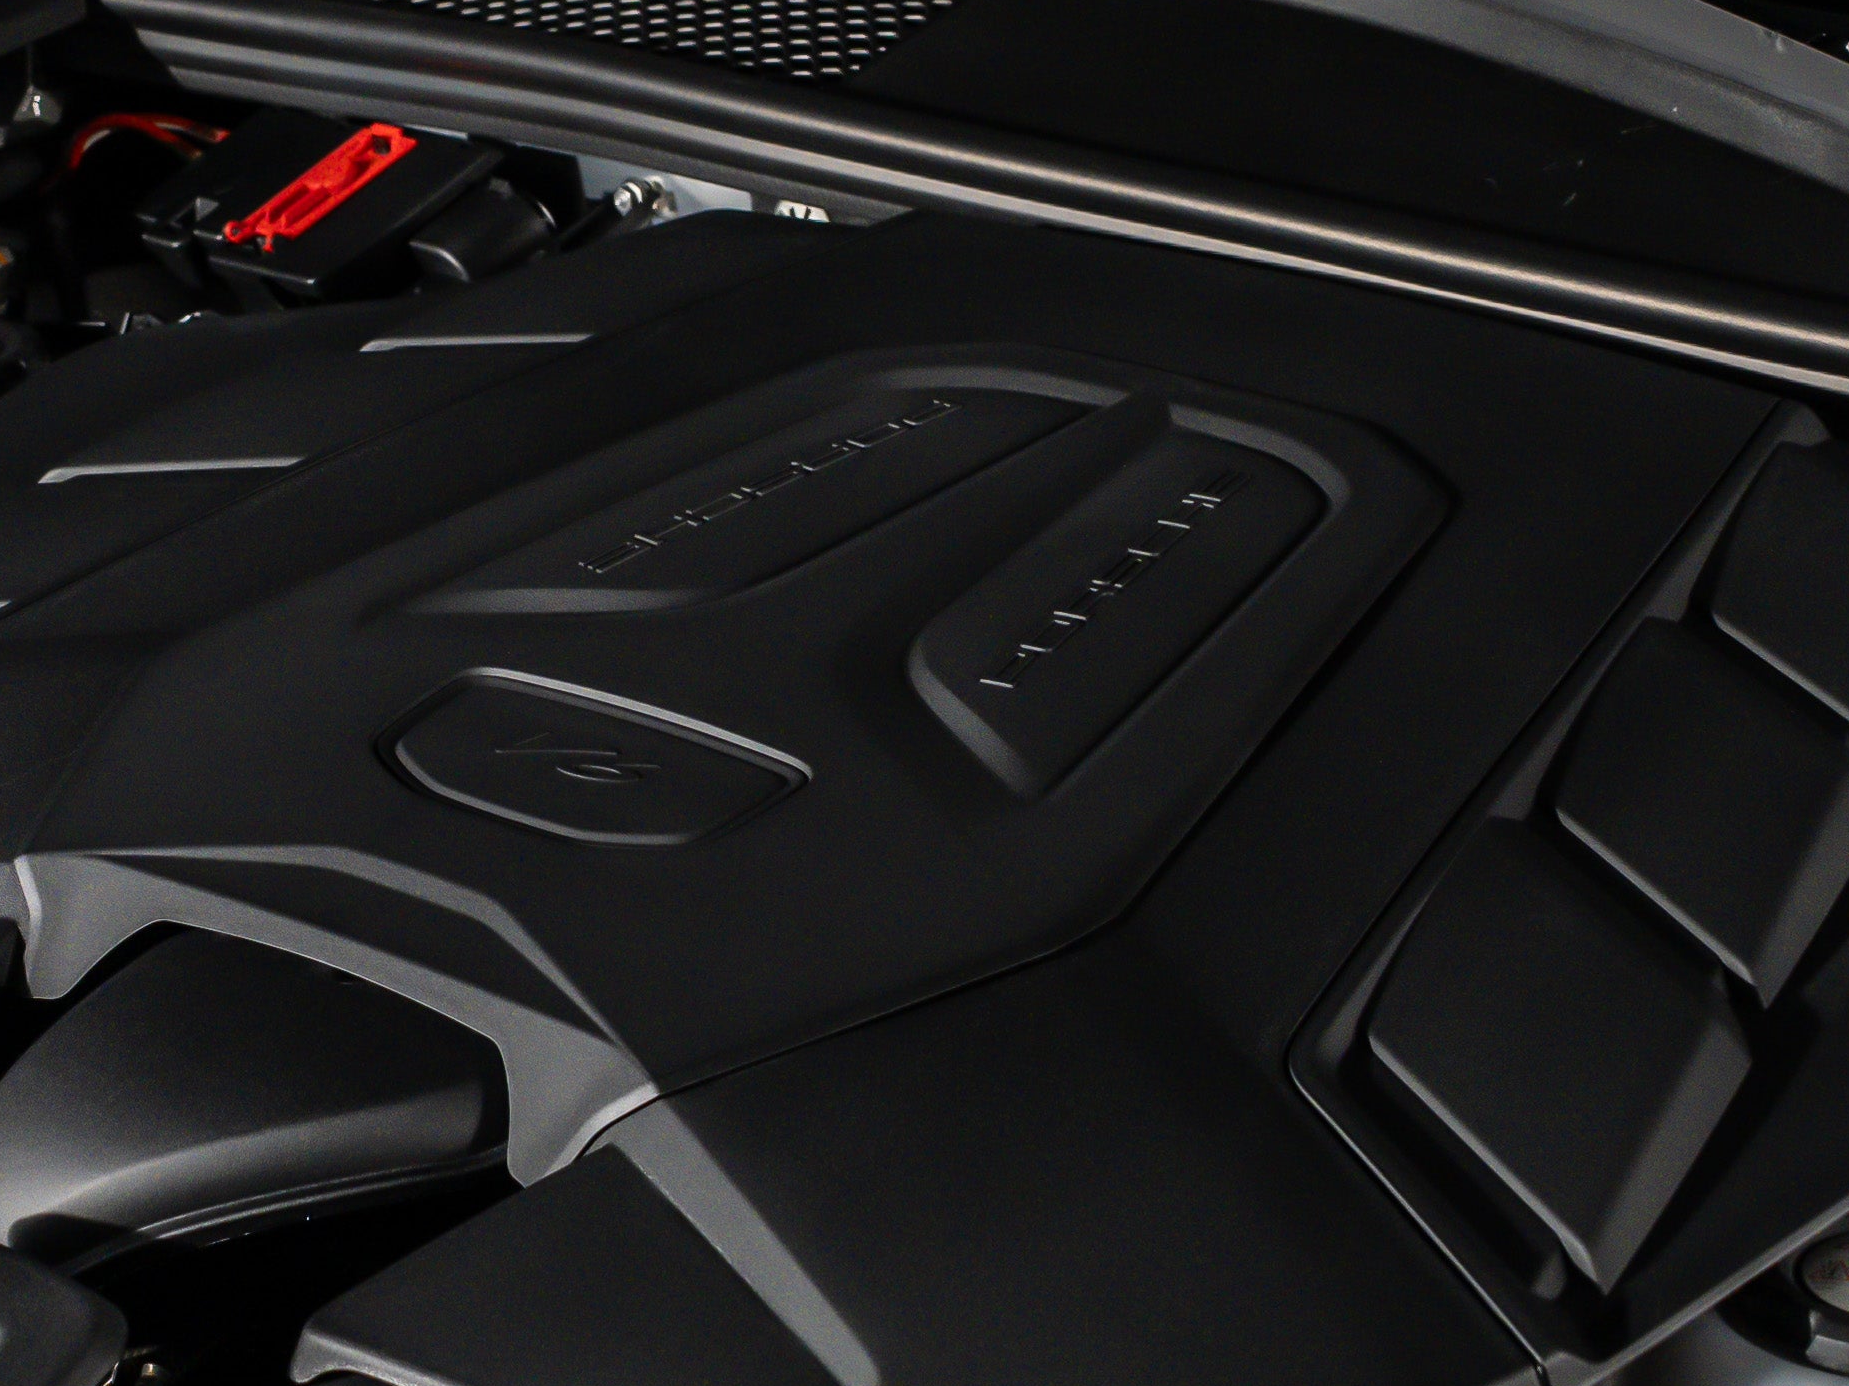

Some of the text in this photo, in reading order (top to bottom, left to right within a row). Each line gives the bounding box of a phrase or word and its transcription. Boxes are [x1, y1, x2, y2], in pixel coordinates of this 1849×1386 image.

[579, 399, 962, 574] PORSCHE
[979, 468, 1253, 689] PORSCHE
[495, 731, 661, 783] V6
